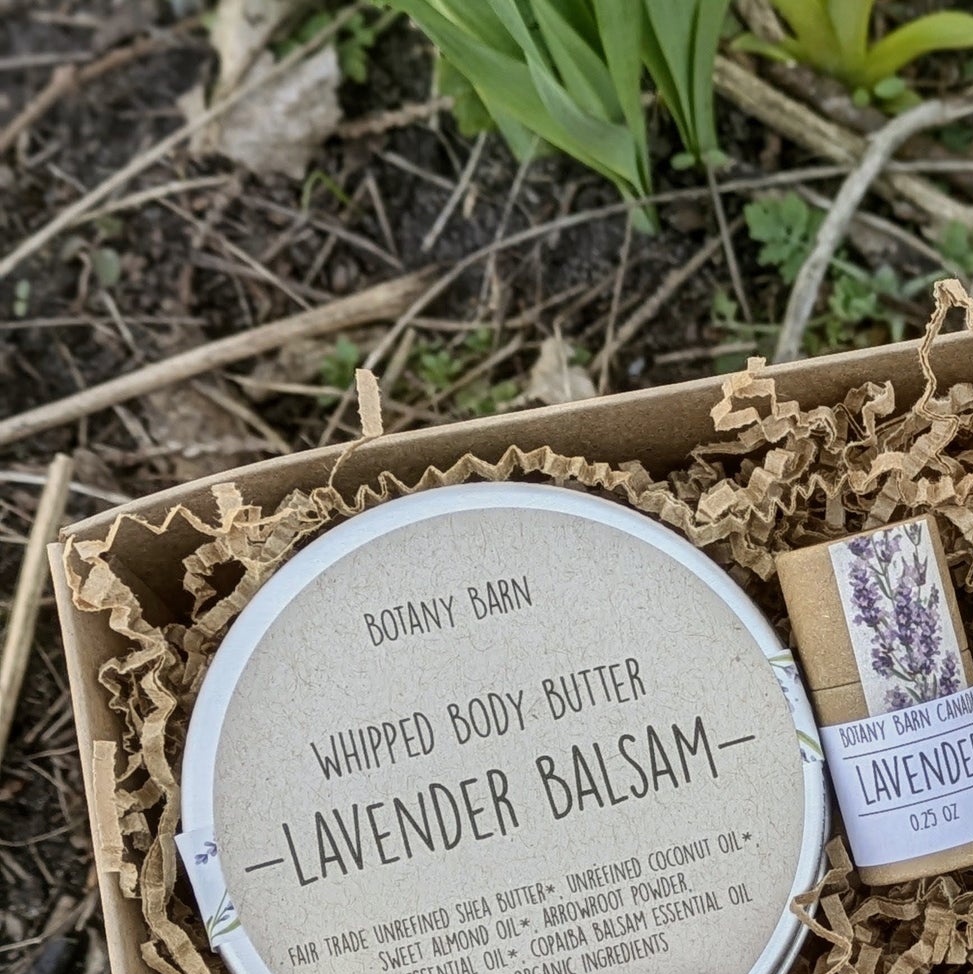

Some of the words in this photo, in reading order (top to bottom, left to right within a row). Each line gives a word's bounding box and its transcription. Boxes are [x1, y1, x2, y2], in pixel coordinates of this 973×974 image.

[363, 596, 456, 646] BOTANY
[467, 576, 533, 620] BARN
[310, 712, 435, 780] WHIPPED
[447, 690, 526, 744] BODY
[542, 657, 646, 720] BUTTER
[838, 720, 886, 749] BOTANY
[890, 707, 931, 736] BARN
[910, 808, 938, 833] 0.25
[942, 803, 960, 822] OZ
[288, 941, 319, 966] FAIR
[324, 929, 369, 957] TRADE
[373, 907, 450, 944] UNREFINED
[455, 896, 492, 924] SHEA
[566, 857, 642, 893] UNREFINED
[648, 838, 711, 872] COCONUT
[378, 941, 424, 971] SWEET
[432, 924, 489, 958] ALMOND
[543, 888, 625, 928] ARROWROOT
[530, 925, 588, 958] COPAIBA
[592, 911, 648, 943] BALSAM
[652, 891, 723, 927] ESSENTIAL
[728, 883, 753, 906] OIL
[581, 932, 669, 974] INGREDIENTS
